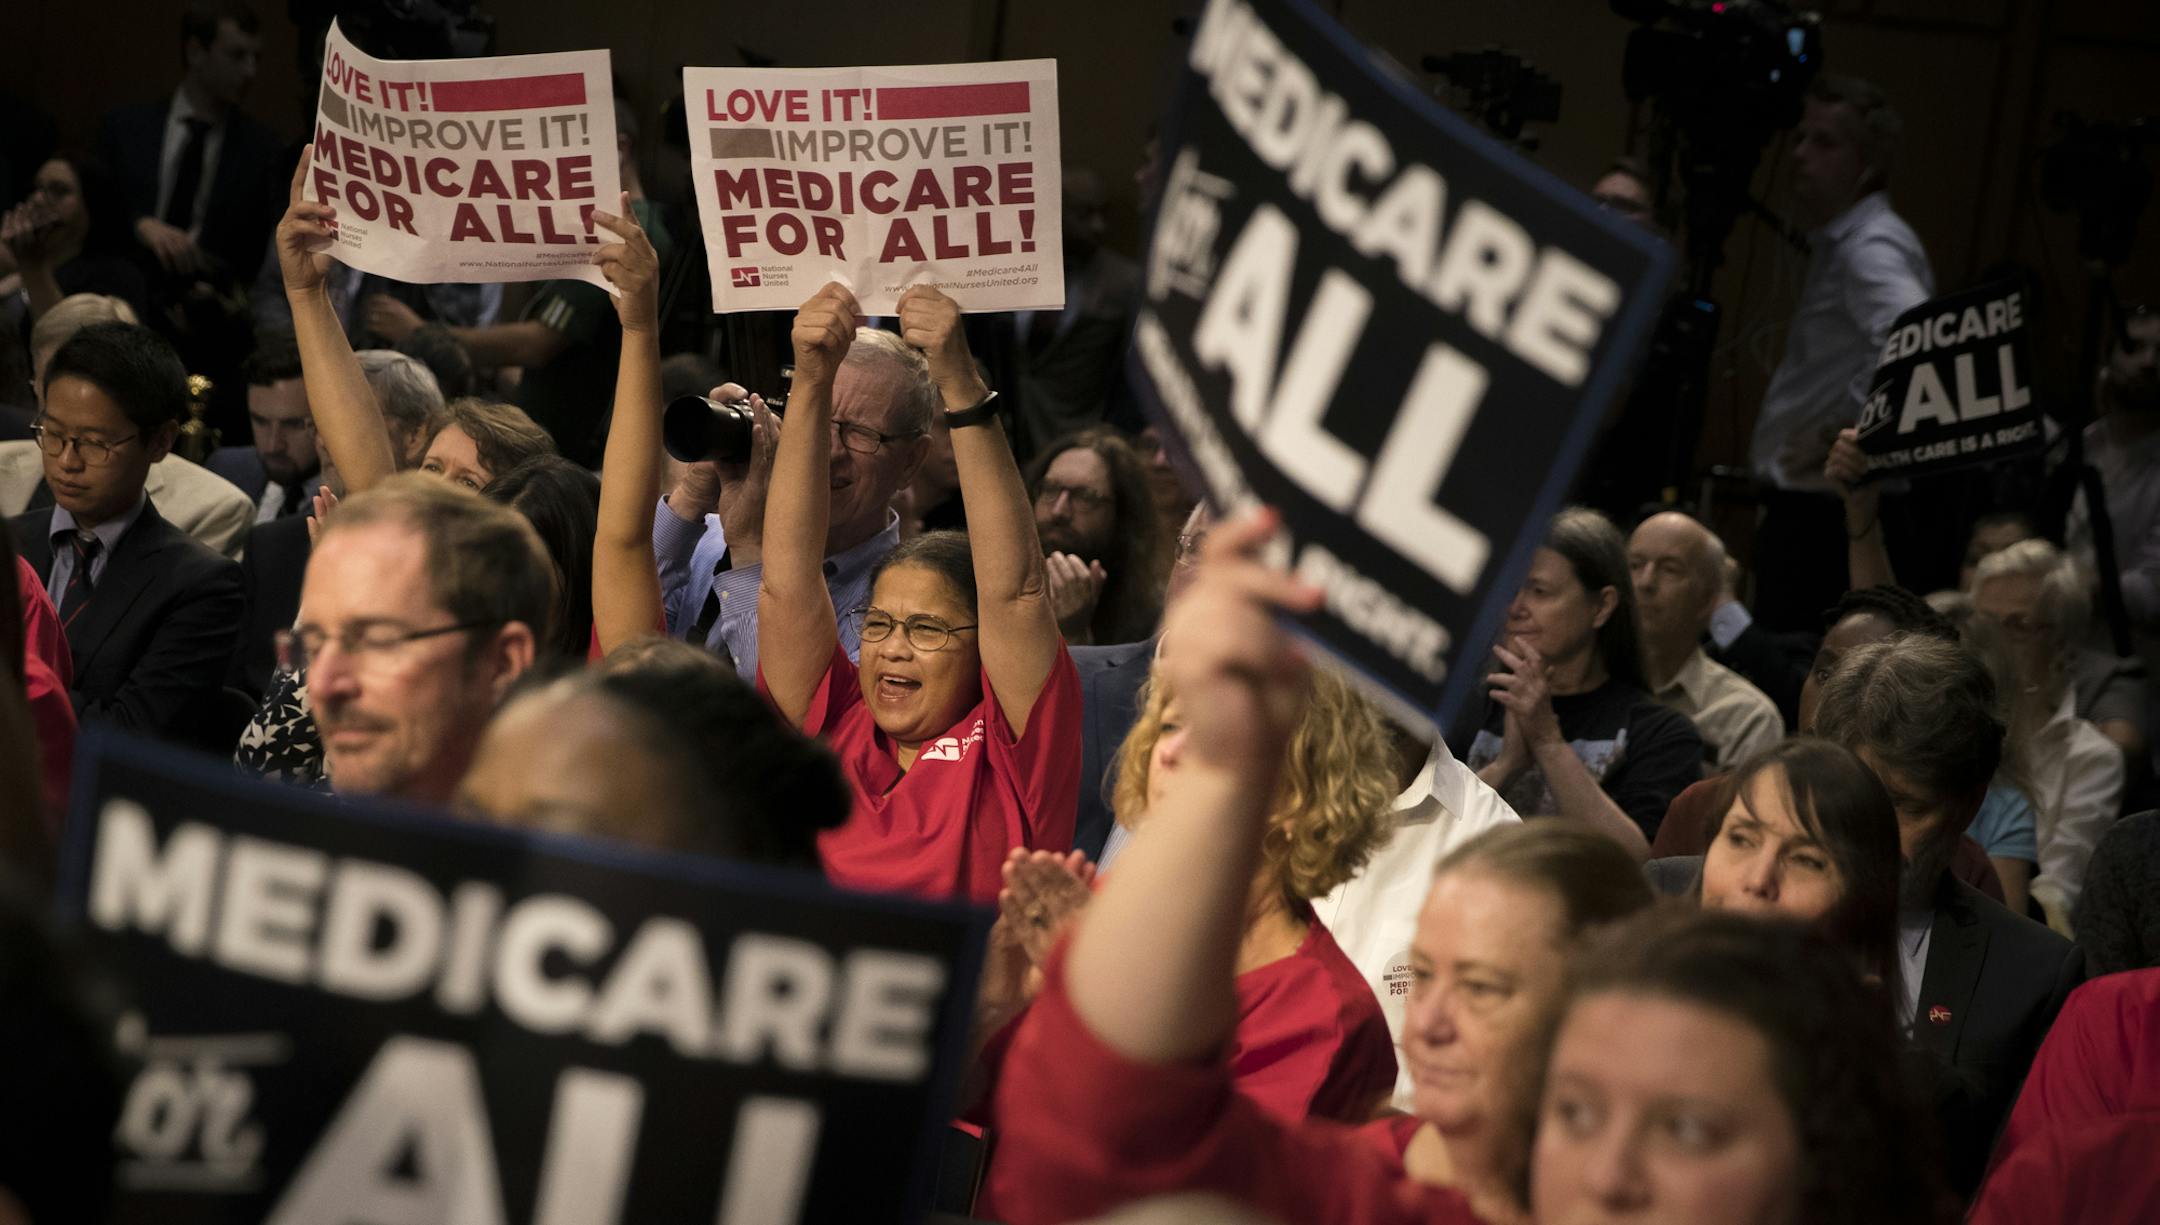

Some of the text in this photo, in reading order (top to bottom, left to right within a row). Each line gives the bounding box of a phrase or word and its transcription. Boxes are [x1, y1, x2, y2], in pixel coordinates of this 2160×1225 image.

[326, 42, 429, 112] LOVE IT!
[706, 88, 873, 122] LOVE IT!
[314, 121, 595, 200] MEDICARE
[350, 103, 590, 151] IMPROVE IT!
[775, 121, 1032, 162] IMPROVE IT!
[314, 166, 600, 244] FOR ALL!
[714, 162, 1035, 215] MEDICARE
[1189, 0, 1621, 387] MEDICARE
[341, 223, 368, 235] National
[722, 209, 1036, 263] FOR ALL!
[966, 264, 1038, 277] #Medicare4All
[1877, 292, 2023, 367] EDICARE
[1193, 204, 1490, 595] ALL
[1897, 343, 2032, 435] ALL
[86, 796, 947, 1083] MEDICARE
